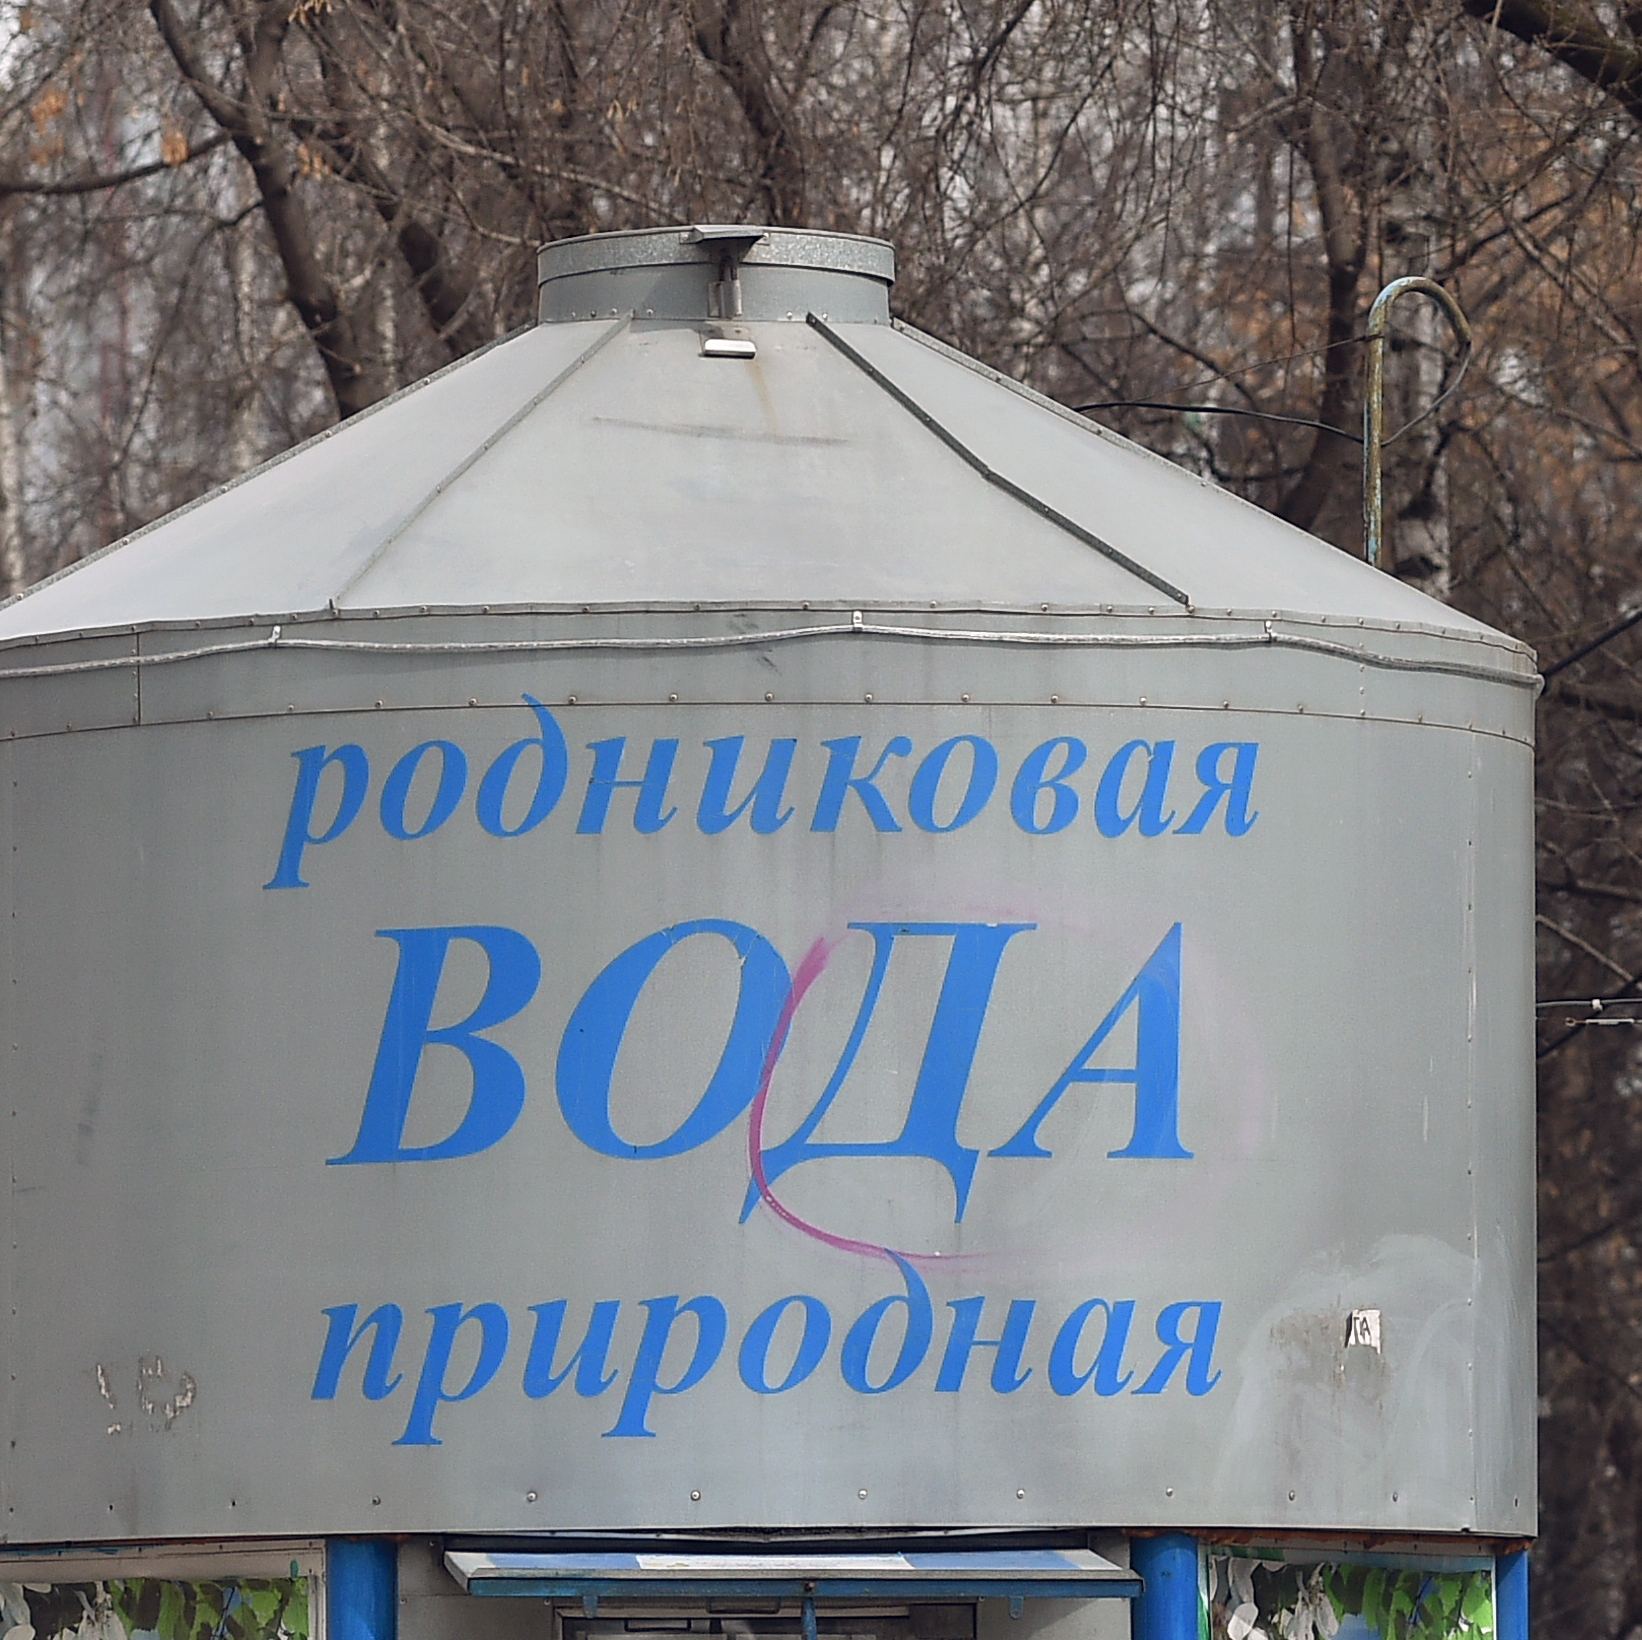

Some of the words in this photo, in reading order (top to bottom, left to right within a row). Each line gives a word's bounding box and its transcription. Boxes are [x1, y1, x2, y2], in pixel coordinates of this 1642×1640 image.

[263, 693, 1259, 890] родниковая
[327, 919, 1195, 1224] ВОДА
[311, 1250, 1222, 1446] природная
